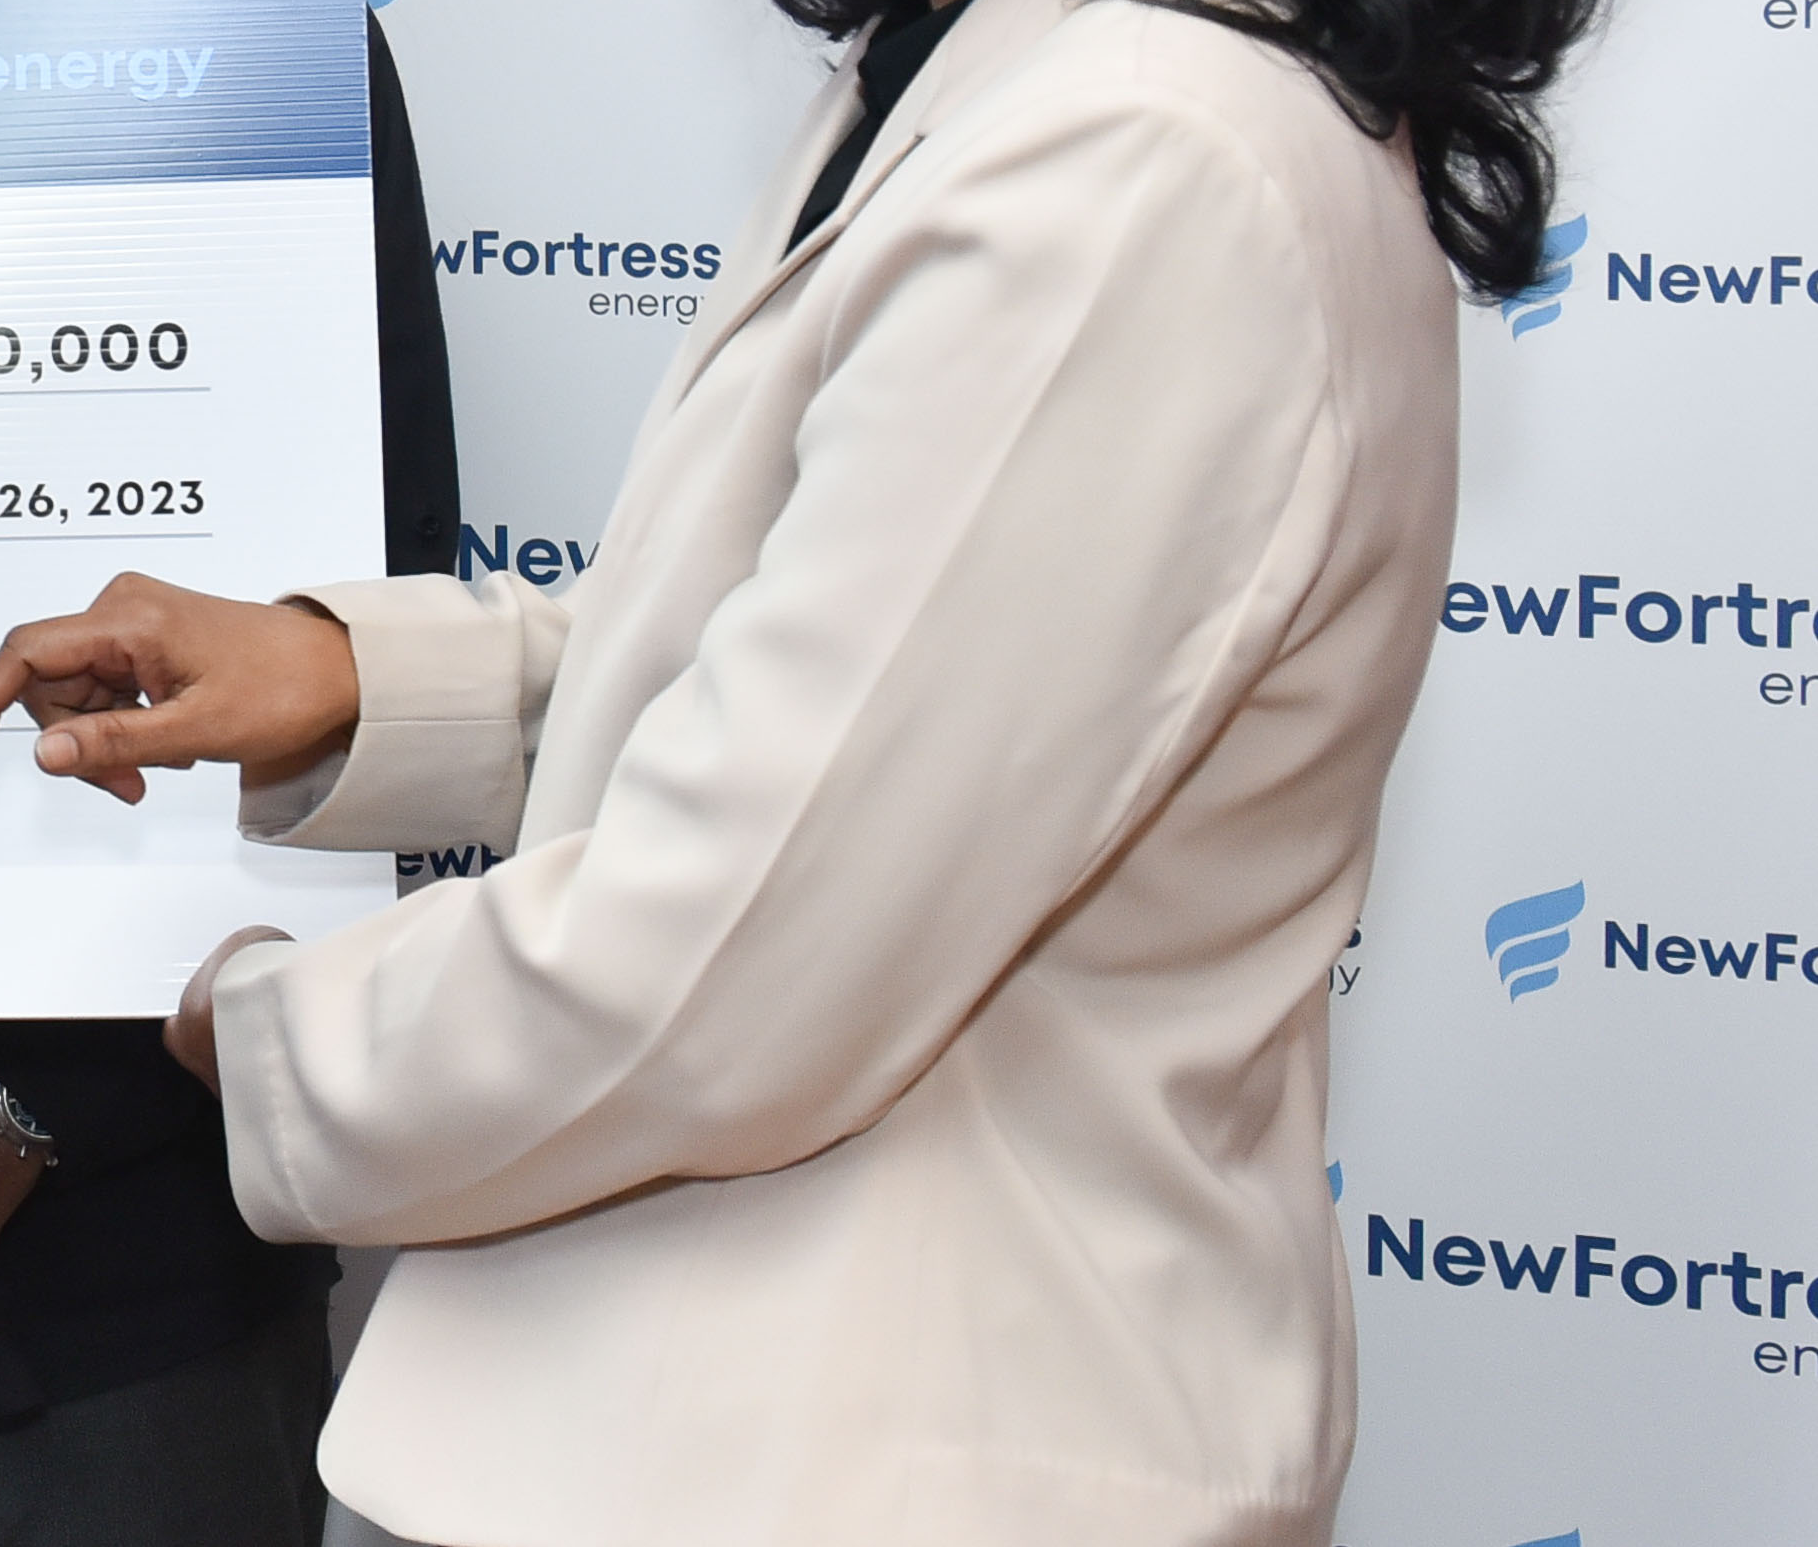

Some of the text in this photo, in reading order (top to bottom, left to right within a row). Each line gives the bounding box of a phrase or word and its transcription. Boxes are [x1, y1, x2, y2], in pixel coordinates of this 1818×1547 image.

[588, 291, 705, 325] energ
[87, 480, 205, 517] 2023
[1440, 574, 1818, 649] ewFortr
[1367, 1213, 1818, 1320] NewFortr
